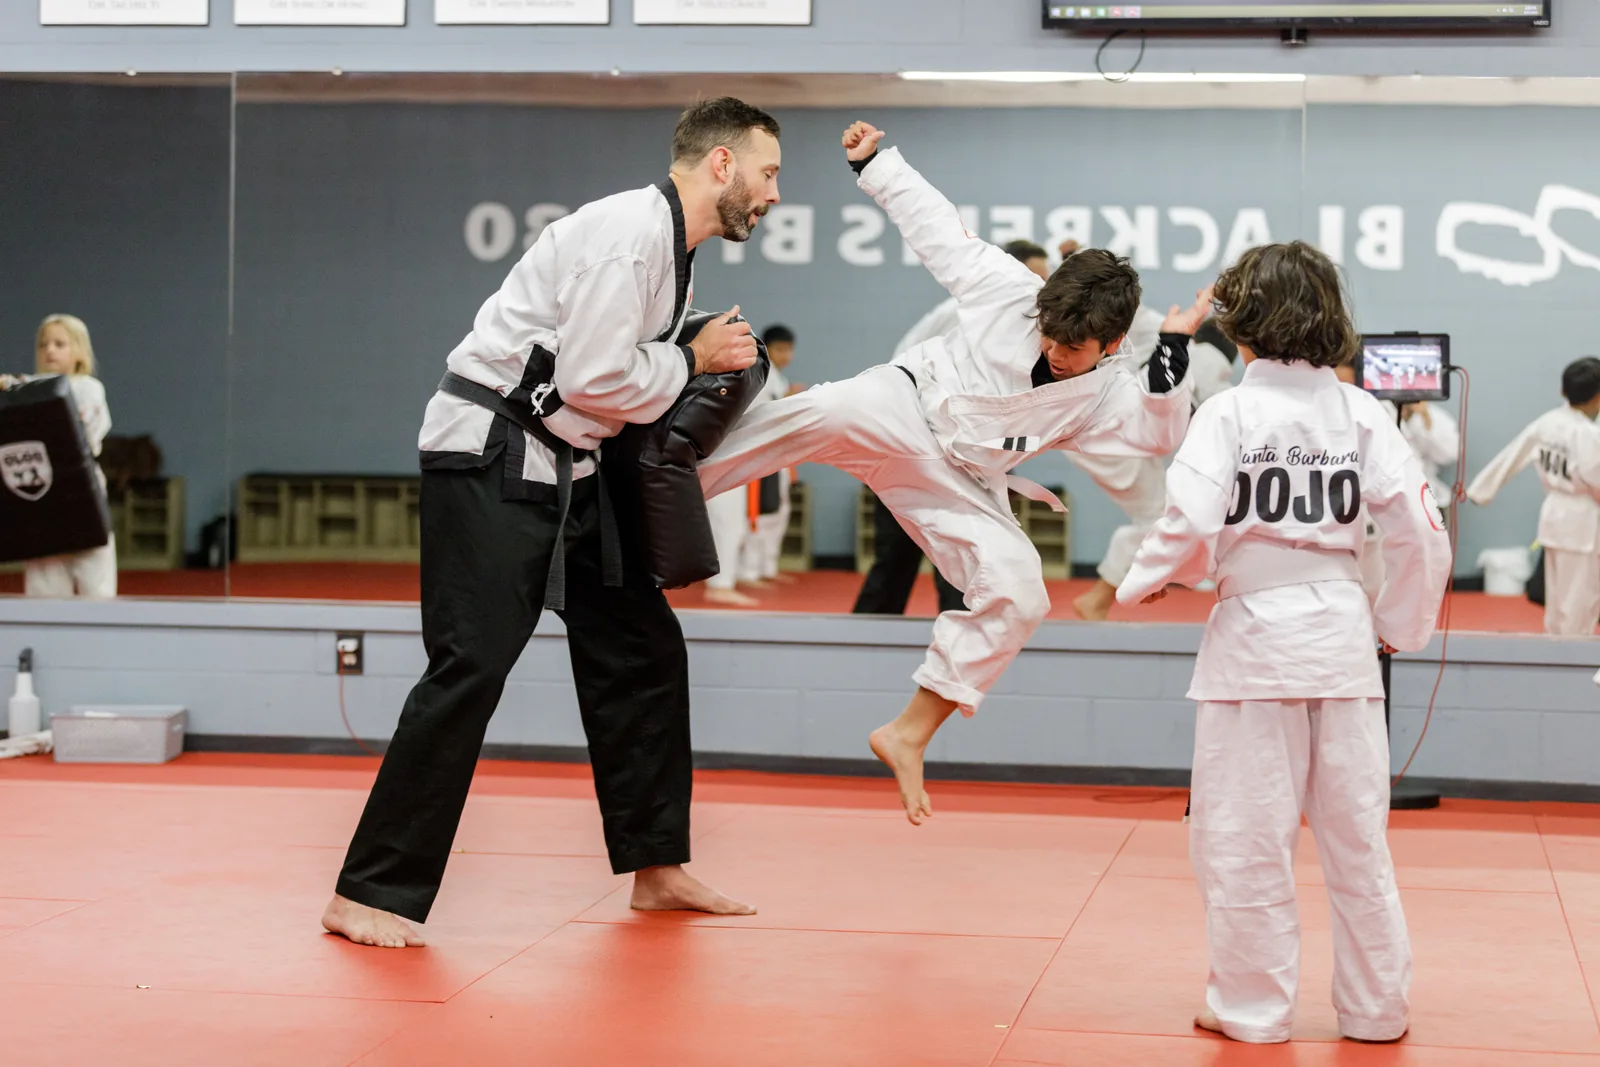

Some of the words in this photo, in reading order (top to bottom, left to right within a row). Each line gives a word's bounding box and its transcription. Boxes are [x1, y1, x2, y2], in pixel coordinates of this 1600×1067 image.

[1239, 444, 1278, 464] anta
[1286, 445, 1360, 466] Barbara
[1224, 467, 1361, 525] DOJO
